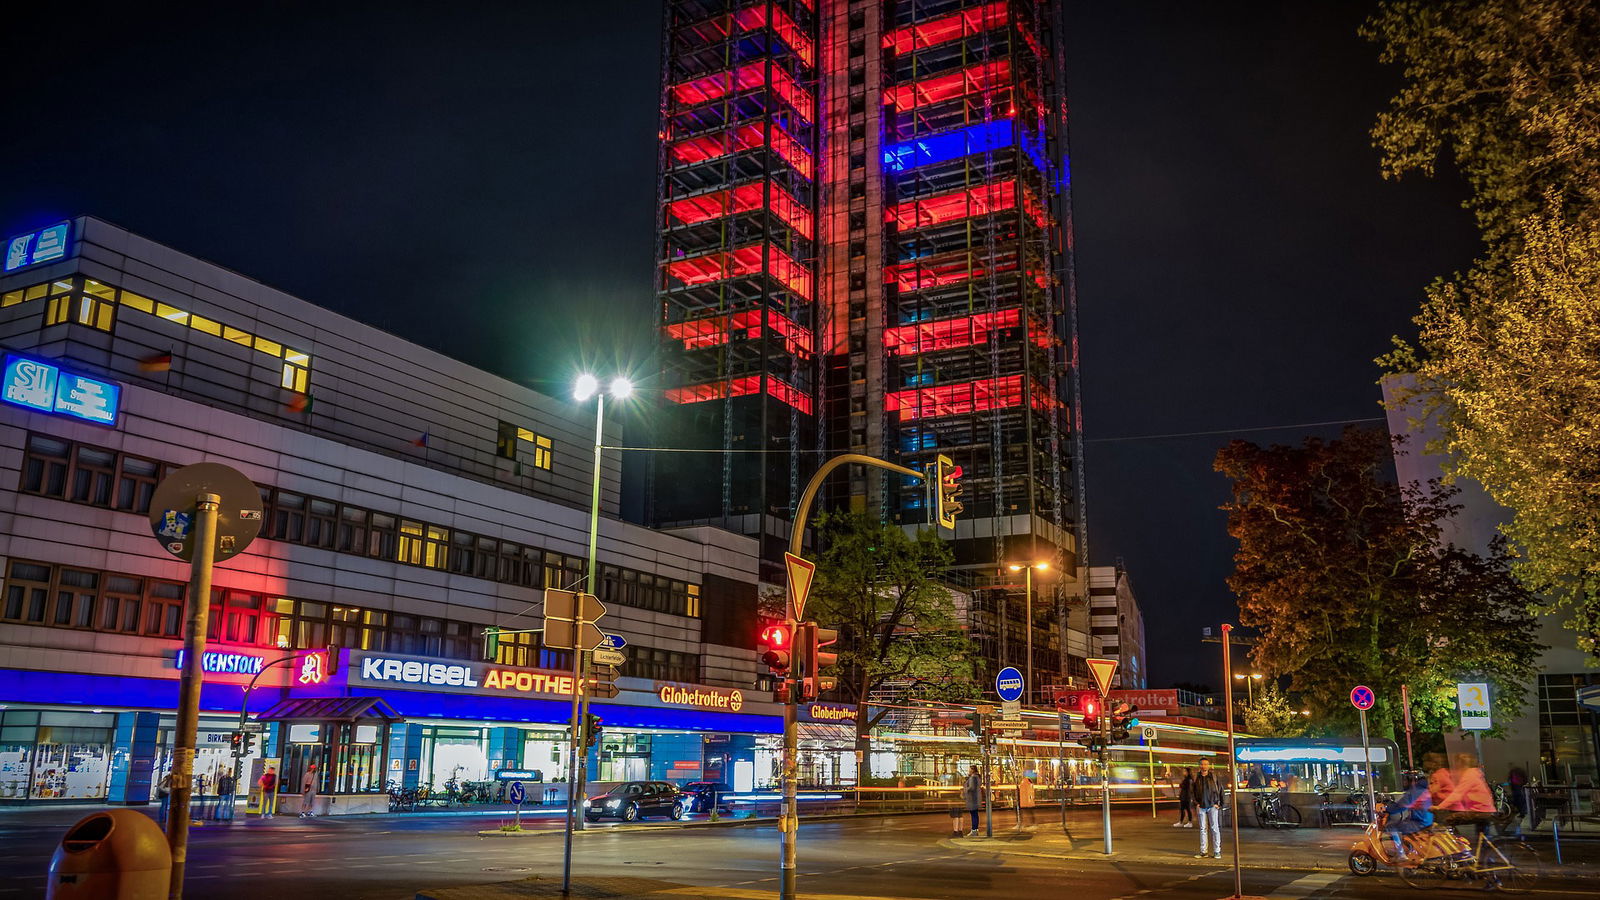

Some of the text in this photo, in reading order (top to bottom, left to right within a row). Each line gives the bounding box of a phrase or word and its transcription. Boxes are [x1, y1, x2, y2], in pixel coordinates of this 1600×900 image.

[177, 650, 263, 674] KENSTOCK
[661, 686, 730, 708] Globetrotter
[811, 704, 856, 720] Globetrotter
